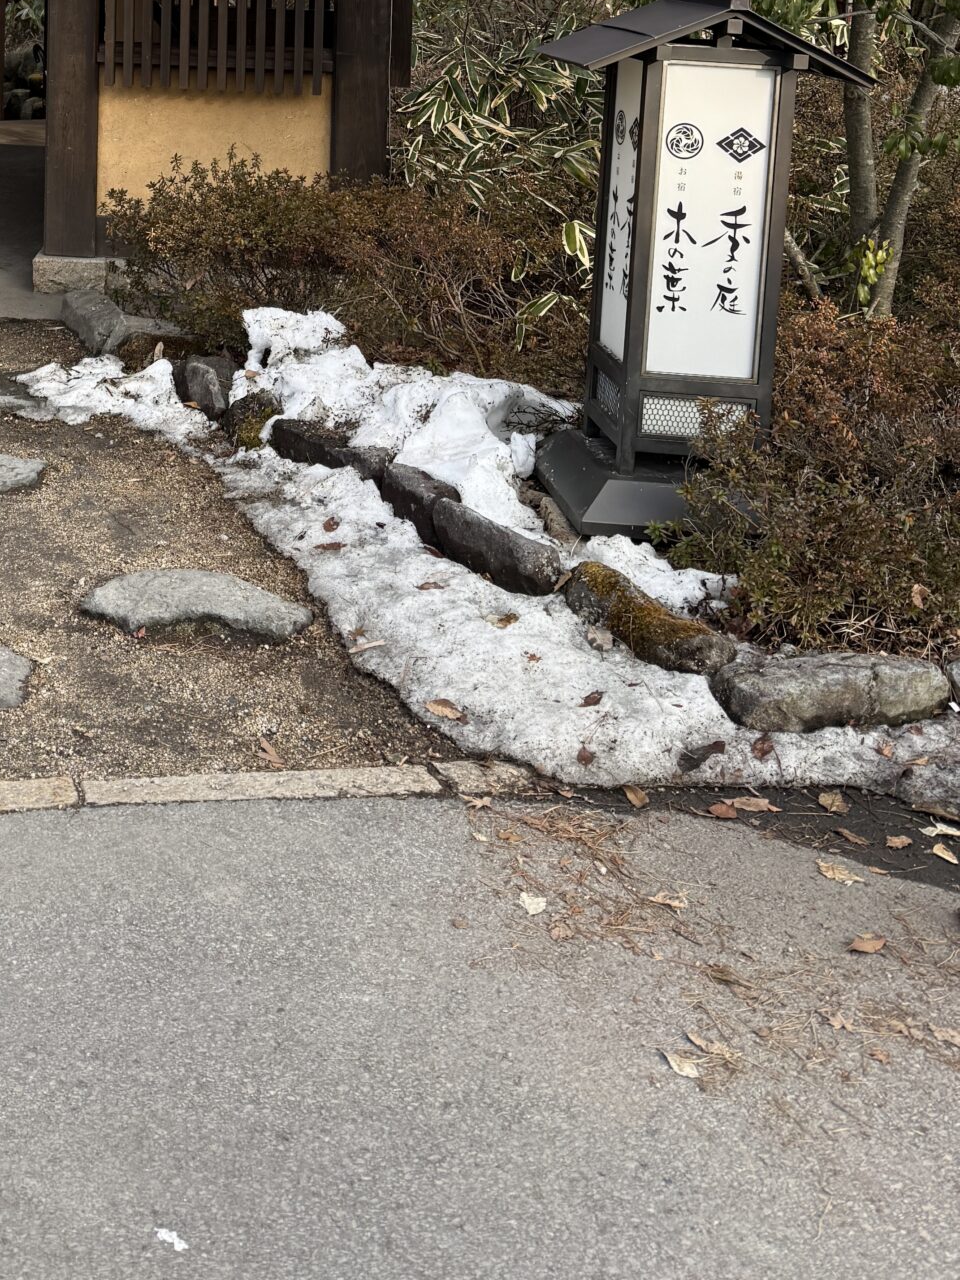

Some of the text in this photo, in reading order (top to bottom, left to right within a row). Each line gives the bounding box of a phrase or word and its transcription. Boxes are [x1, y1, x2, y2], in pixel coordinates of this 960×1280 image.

[656, 201, 697, 312] 木の葉
[701, 205, 752, 315] 季の庭
